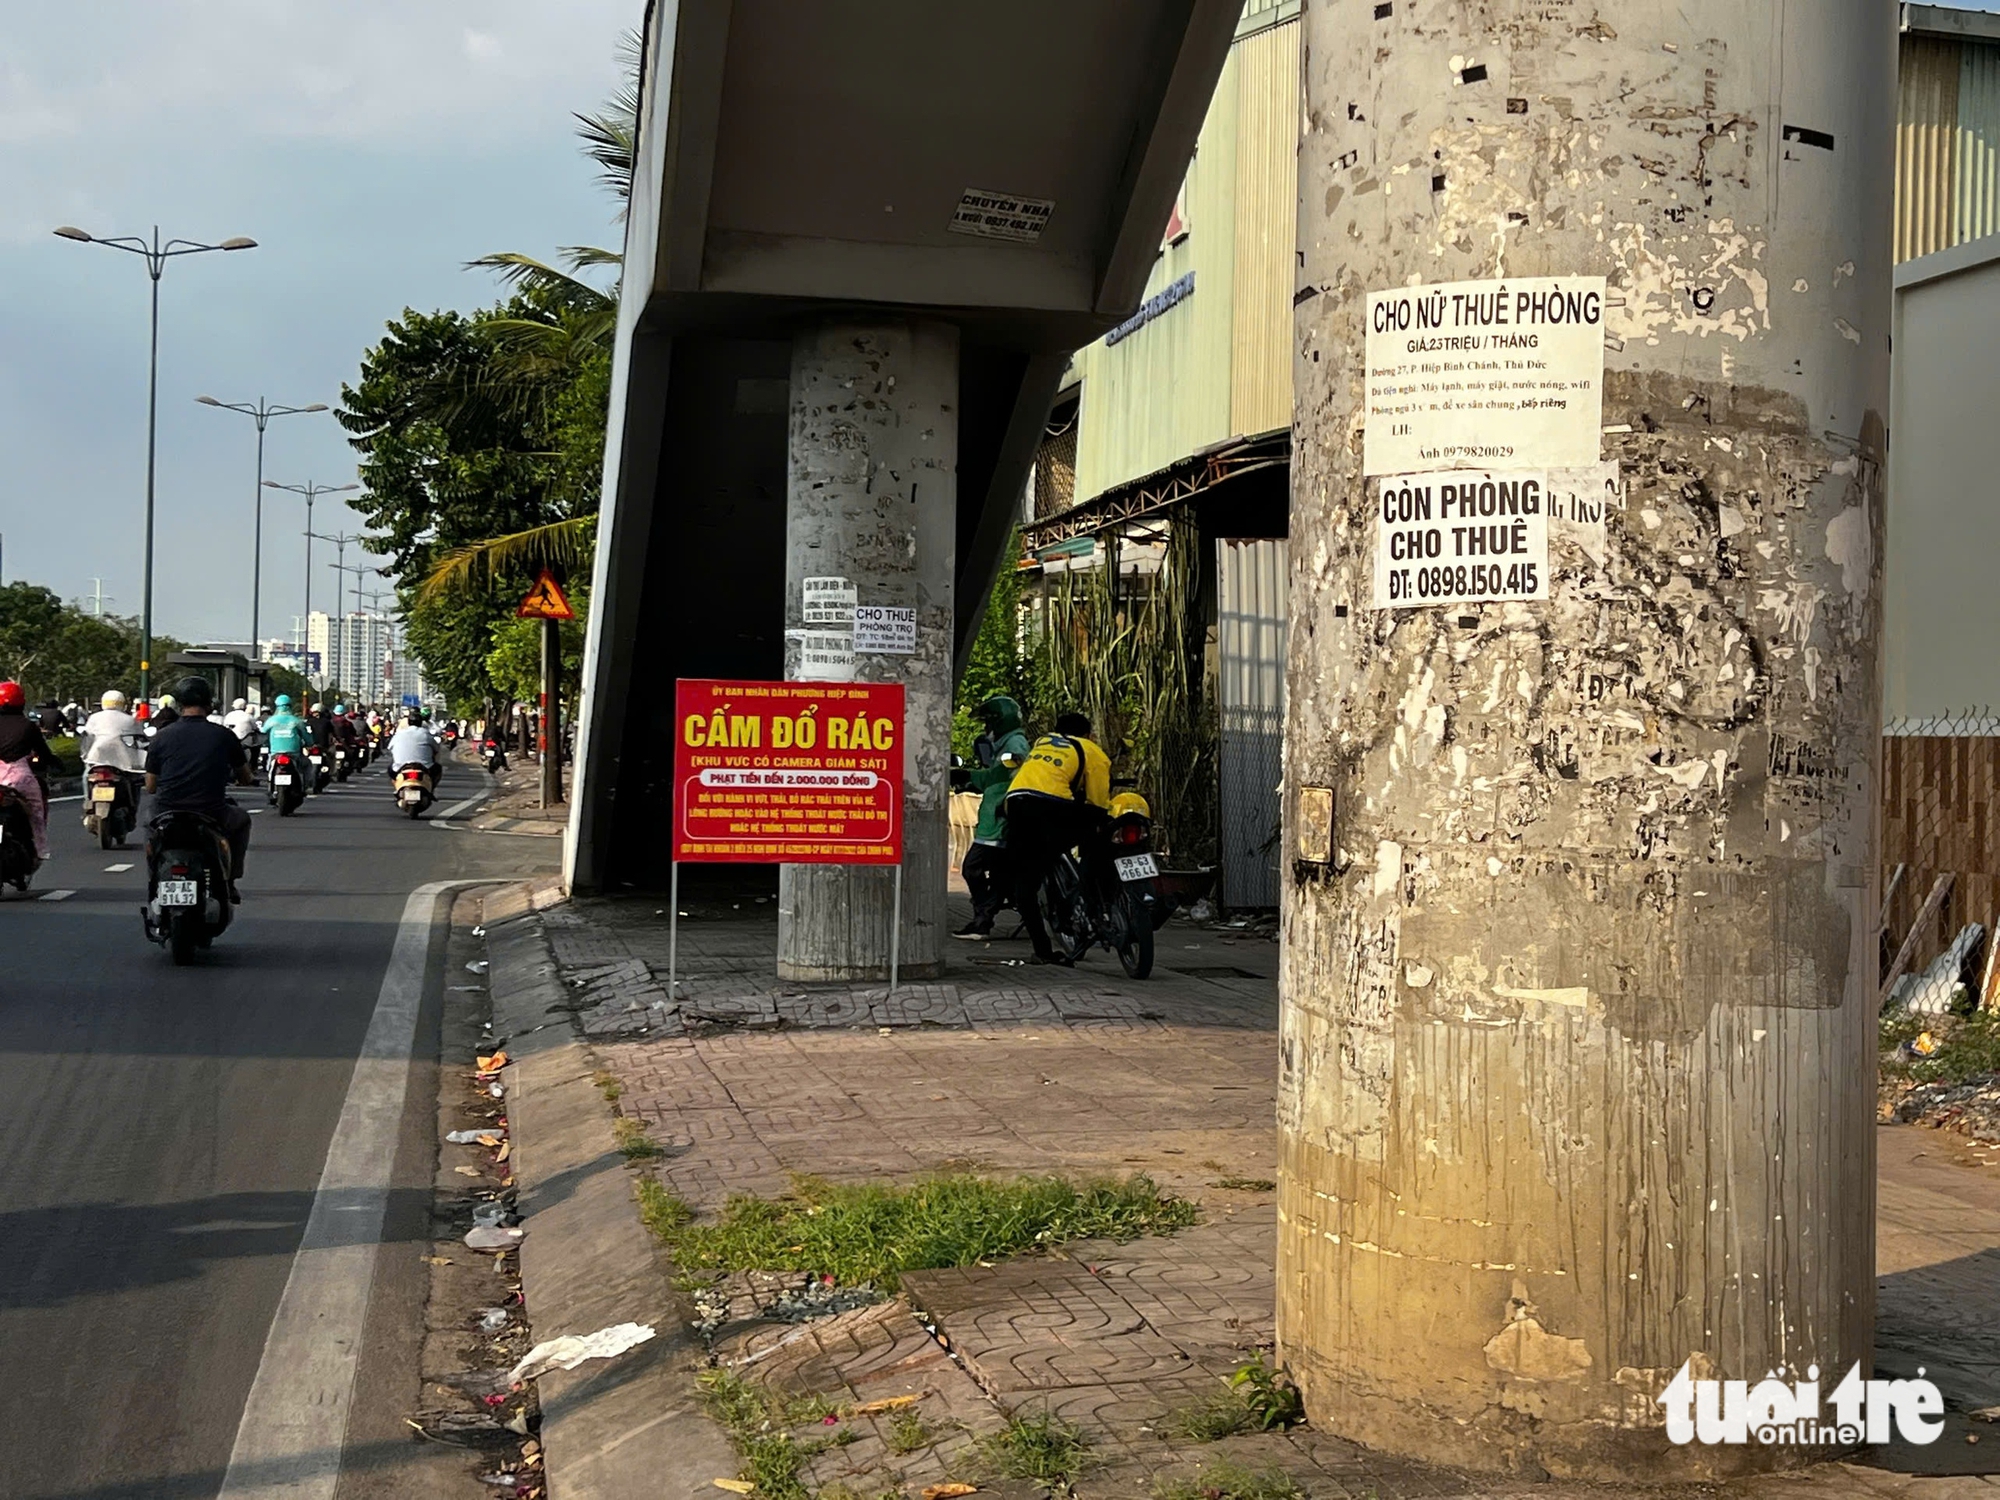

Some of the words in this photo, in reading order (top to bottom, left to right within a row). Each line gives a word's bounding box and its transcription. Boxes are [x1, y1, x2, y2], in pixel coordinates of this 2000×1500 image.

[1374, 299, 1411, 333] CHO
[1416, 289, 1447, 329] NỮ
[1452, 284, 1509, 327] THUÊ
[1516, 284, 1601, 325] PHÒNG
[1491, 331, 1539, 348] THÁNG
[1467, 380, 1486, 391] máy
[1391, 424, 1413, 436] LH:
[1443, 446, 1514, 458] 0979820029
[1383, 480, 1431, 524] CÒN
[1440, 473, 1540, 519] PHÒNG
[1390, 528, 1442, 560] CHO
[1451, 518, 1528, 557] THUÊ
[1389, 569, 1413, 600] ĐT:
[1417, 562, 1539, 598] 0898.150.415
[856, 608, 883, 620] CHO
[885, 609, 915, 622] THUÊ
[859, 622, 893, 632] PHÒNG
[895, 624, 913, 634] TRỌ
[684, 703, 761, 748] CẤM
[771, 703, 819, 749] ĐỔ
[827, 711, 894, 750] RÁC
[753, 754, 770, 767] CÓ
[773, 757, 821, 768] CAMERA
[825, 756, 856, 768] GIÁM
[709, 773, 737, 785] PHẠT
[786, 775, 840, 785] 2.000.000
